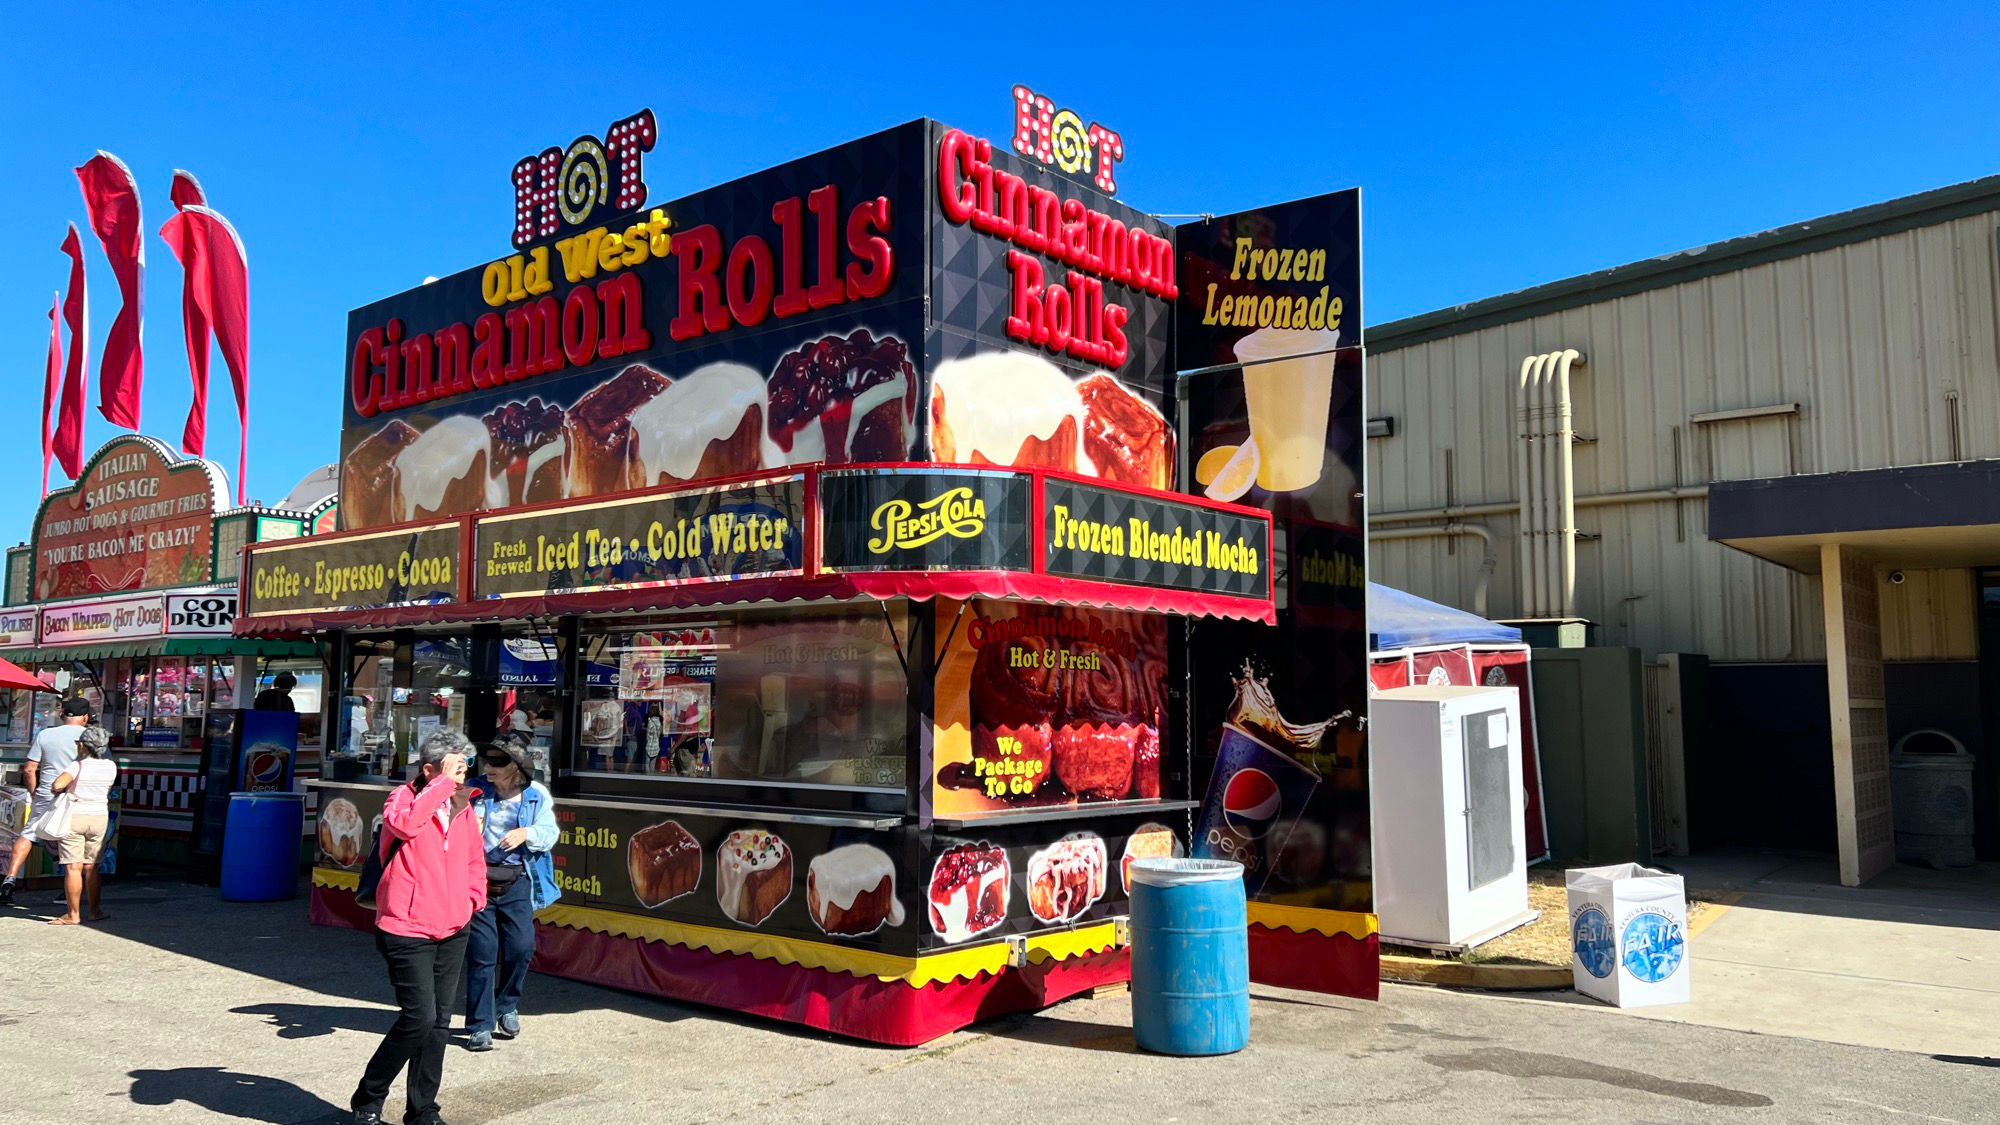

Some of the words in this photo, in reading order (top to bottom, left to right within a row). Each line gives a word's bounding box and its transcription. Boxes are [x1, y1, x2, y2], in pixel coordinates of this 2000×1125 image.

[1012, 84, 1124, 195] HOT
[513, 110, 657, 248] HOT
[938, 129, 1178, 299] Cinnamon
[482, 246, 553, 306] Old
[555, 210, 672, 283] West
[1230, 237, 1326, 282] Frozen
[351, 272, 651, 418] Cinnamon
[670, 184, 894, 341] Rolls
[1006, 249, 1128, 369] Rolls
[1202, 284, 1342, 331] Lemonade
[99, 453, 147, 481] ITALIAN
[44, 519, 70, 538] JUMBO
[73, 516, 90, 533] HOT
[93, 510, 117, 530] DOGS
[120, 509, 129, 524] &
[132, 499, 175, 522] GOURMET
[178, 493, 207, 513] FRIES
[85, 478, 160, 511] SAUSAGE
[88, 537, 125, 559] BACON
[129, 535, 144, 552] ME
[149, 525, 201, 549] CRAZY!"
[493, 539, 527, 559] Fresh
[536, 531, 579, 572] Iced
[586, 528, 622, 568] Tea
[647, 513, 701, 561] Cold
[708, 512, 788, 555] Water
[1053, 505, 1124, 556] Frozen
[1128, 517, 1203, 567] Blended
[1206, 530, 1258, 575] Mocha
[255, 565, 300, 600] Coffee
[314, 560, 384, 601] Espresso
[398, 551, 451, 587] Cocoa
[487, 556, 532, 576] Brewed
[967, 615, 1083, 649] Cinnamon
[1089, 615, 1137, 662] Rolls
[1010, 647, 1039, 668] Hot
[1043, 648, 1055, 668] &
[1060, 650, 1101, 670] Fresh
[974, 758, 1042, 778] Package
[996, 737, 1022, 755] We
[985, 777, 1006, 796] To
[1010, 777, 1033, 794] Go
[574, 826, 618, 849] Rolls
[554, 869, 601, 896] Beach
[1623, 921, 1684, 966] FAIR
